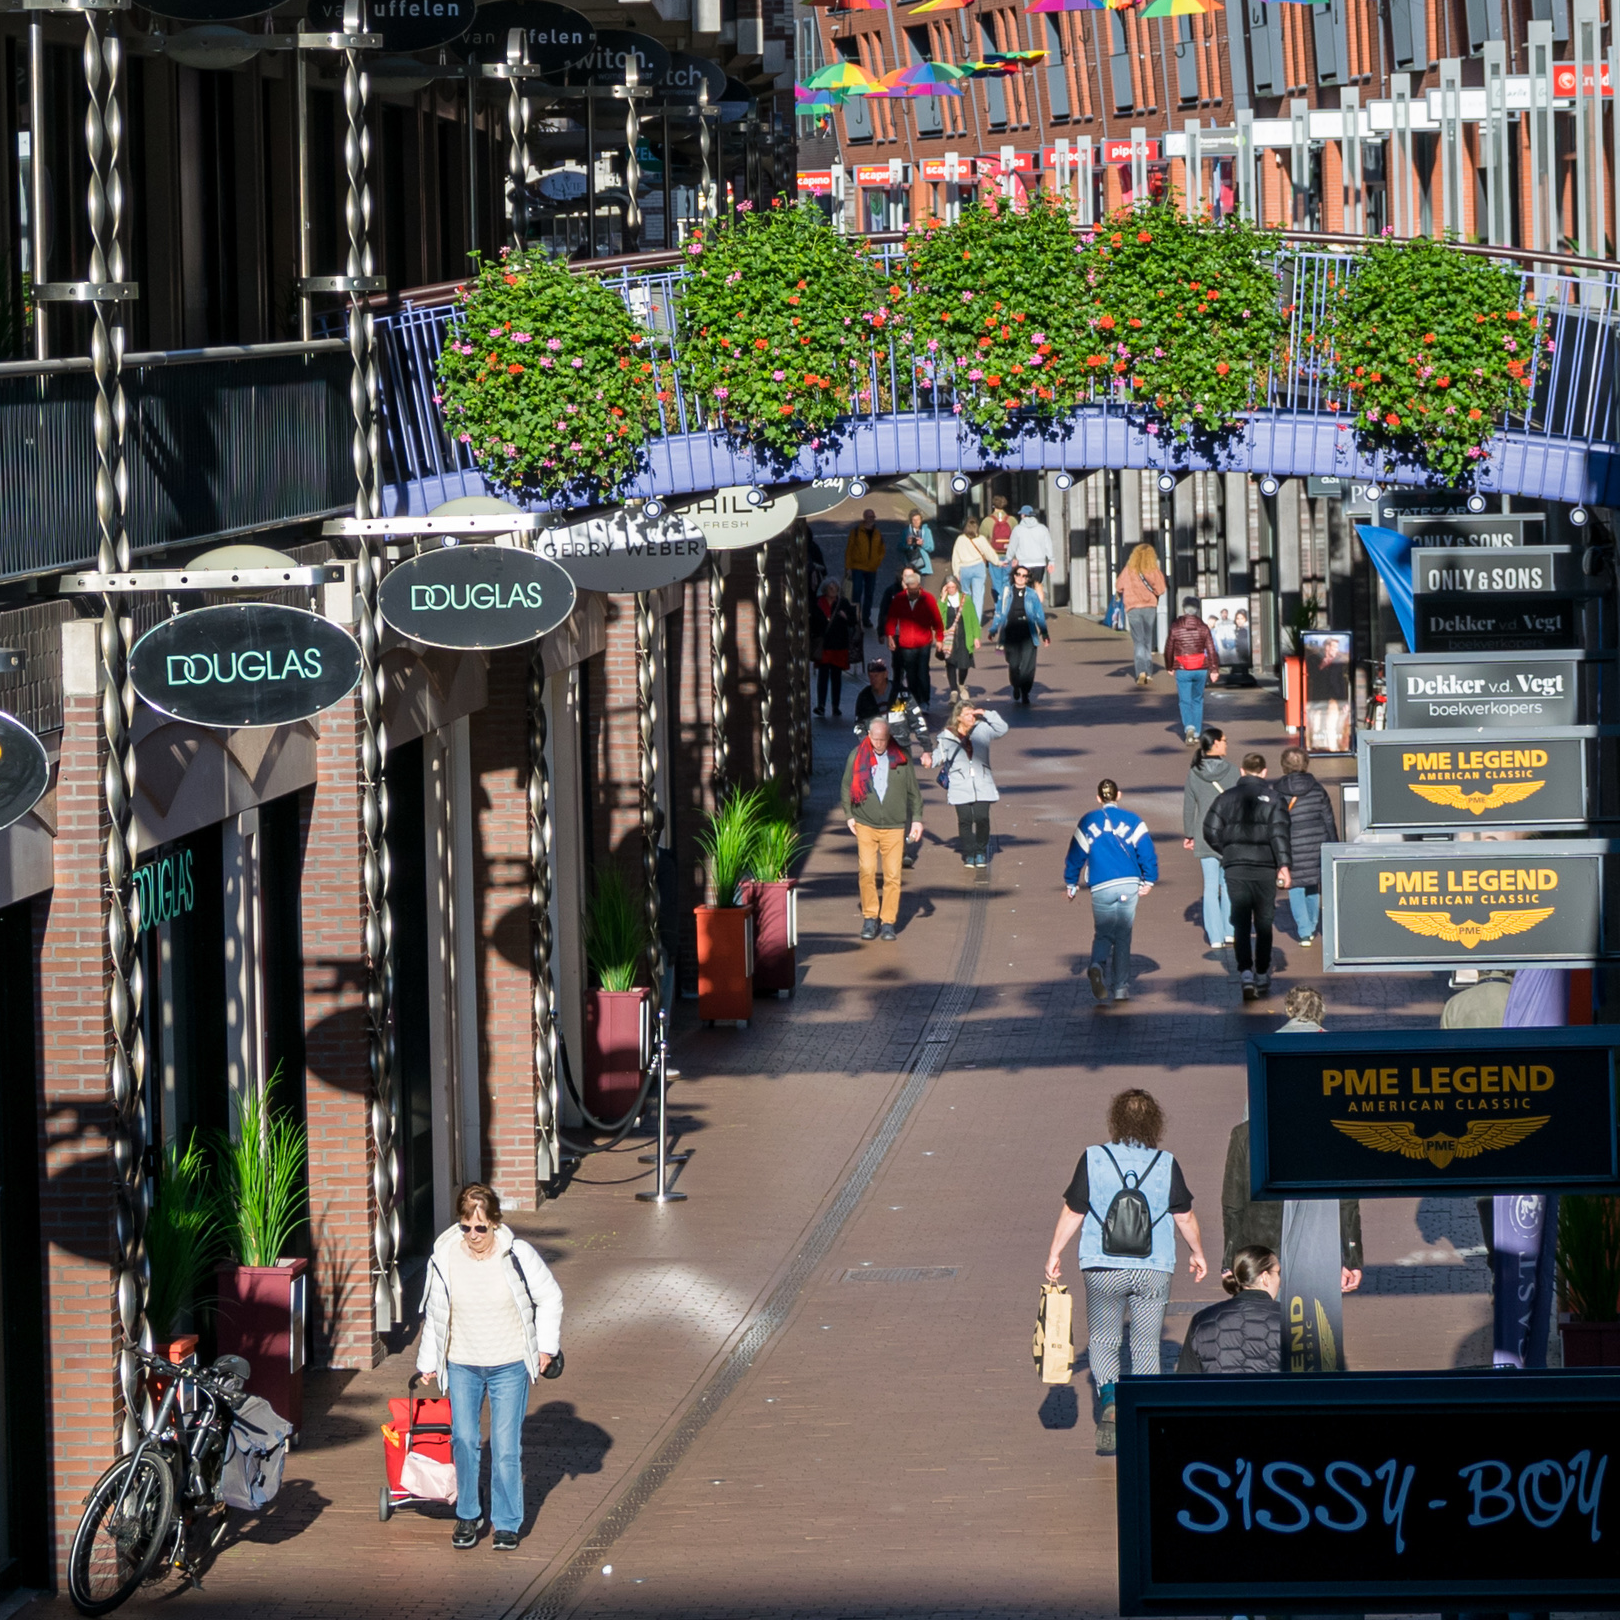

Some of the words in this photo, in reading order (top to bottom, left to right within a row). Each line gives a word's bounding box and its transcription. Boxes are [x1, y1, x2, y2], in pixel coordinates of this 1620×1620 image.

[797, 175, 830, 188] capino
[1383, 506, 1431, 519] STATE
[1447, 506, 1468, 516] AR
[703, 520, 749, 529] FRESH
[1468, 533, 1514, 548] SONS
[543, 540, 612, 559] GERRY
[625, 539, 701, 557] WEBER
[1428, 568, 1475, 591] ONLY
[1477, 570, 1489, 590] &
[1491, 566, 1543, 590] SONS
[410, 581, 543, 612] DOUGLAS
[1430, 615, 1496, 632] Dekker
[1523, 614, 1562, 633] Vegt
[1449, 637, 1545, 651] boekverkopers
[166, 647, 323, 686] DOUGLAS
[1406, 674, 1486, 695] Dekker
[1488, 679, 1514, 693] v.d.
[1516, 674, 1564, 696] Vegt
[1429, 701, 1543, 717] boekverkopers
[1402, 752, 1452, 771] PME
[1457, 749, 1549, 769] LEGEND
[1418, 771, 1480, 781] AMERICAN
[1485, 769, 1533, 779] CLASSIC
[1468, 796, 1486, 804] PME
[1379, 870, 1439, 893] PME
[1447, 868, 1559, 892] LEGEND
[1398, 894, 1474, 906] AMERICAN
[1480, 893, 1540, 905] CLASSIC
[1458, 926, 1481, 935] PME
[1322, 1067, 1400, 1096] PME
[1411, 1065, 1555, 1094] LEGEND
[1347, 1100, 1446, 1113] AMERICAN
[1455, 1097, 1531, 1110] CLASSIC
[1426, 1140, 1456, 1151] PME
